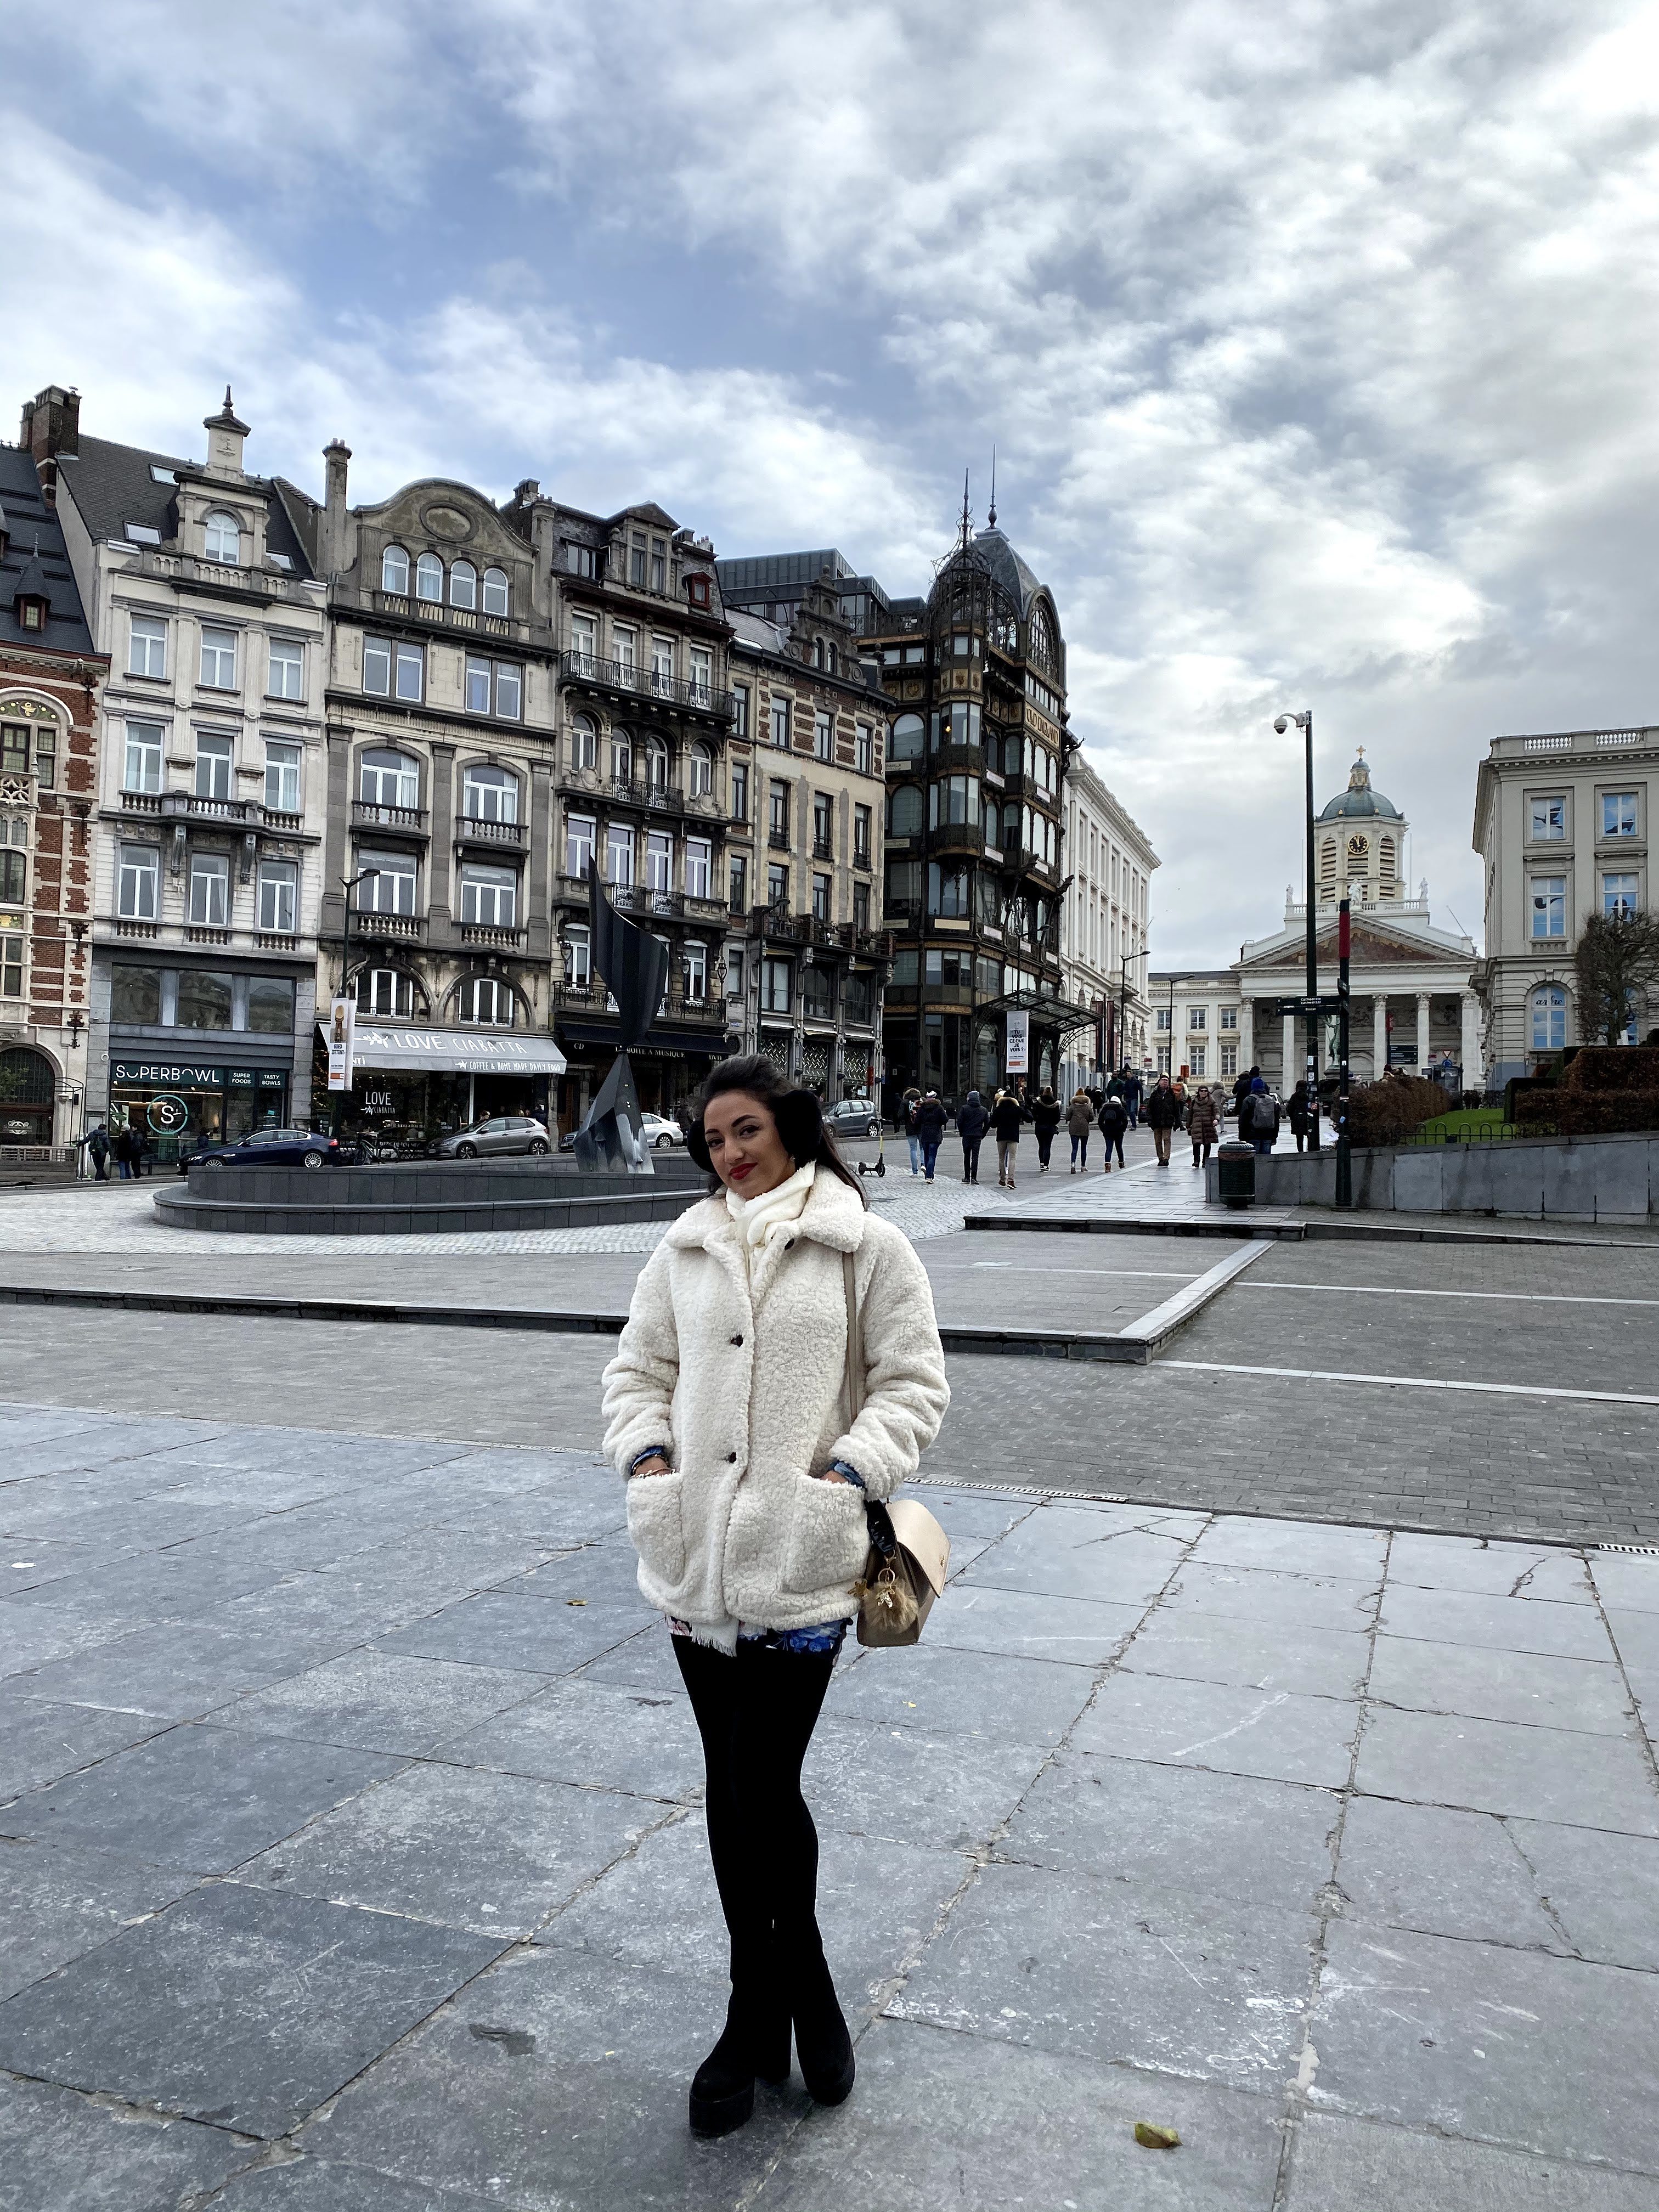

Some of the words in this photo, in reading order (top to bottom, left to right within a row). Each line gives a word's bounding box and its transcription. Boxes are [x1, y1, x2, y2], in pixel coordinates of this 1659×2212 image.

[1027, 709, 1037, 727] OLD
[1037, 716, 1058, 744] ENGLAND
[393, 1034, 446, 1049] LOVE
[452, 1038, 527, 1054] CIABATTA
[655, 1049, 686, 1058] MUSIQUE
[470, 1061, 488, 1070] COFFEE
[497, 1062, 511, 1070] HOME
[548, 1063, 561, 1071] FOOD
[365, 1091, 392, 1105] LOVE
[374, 1106, 396, 1114] CIABATTA
